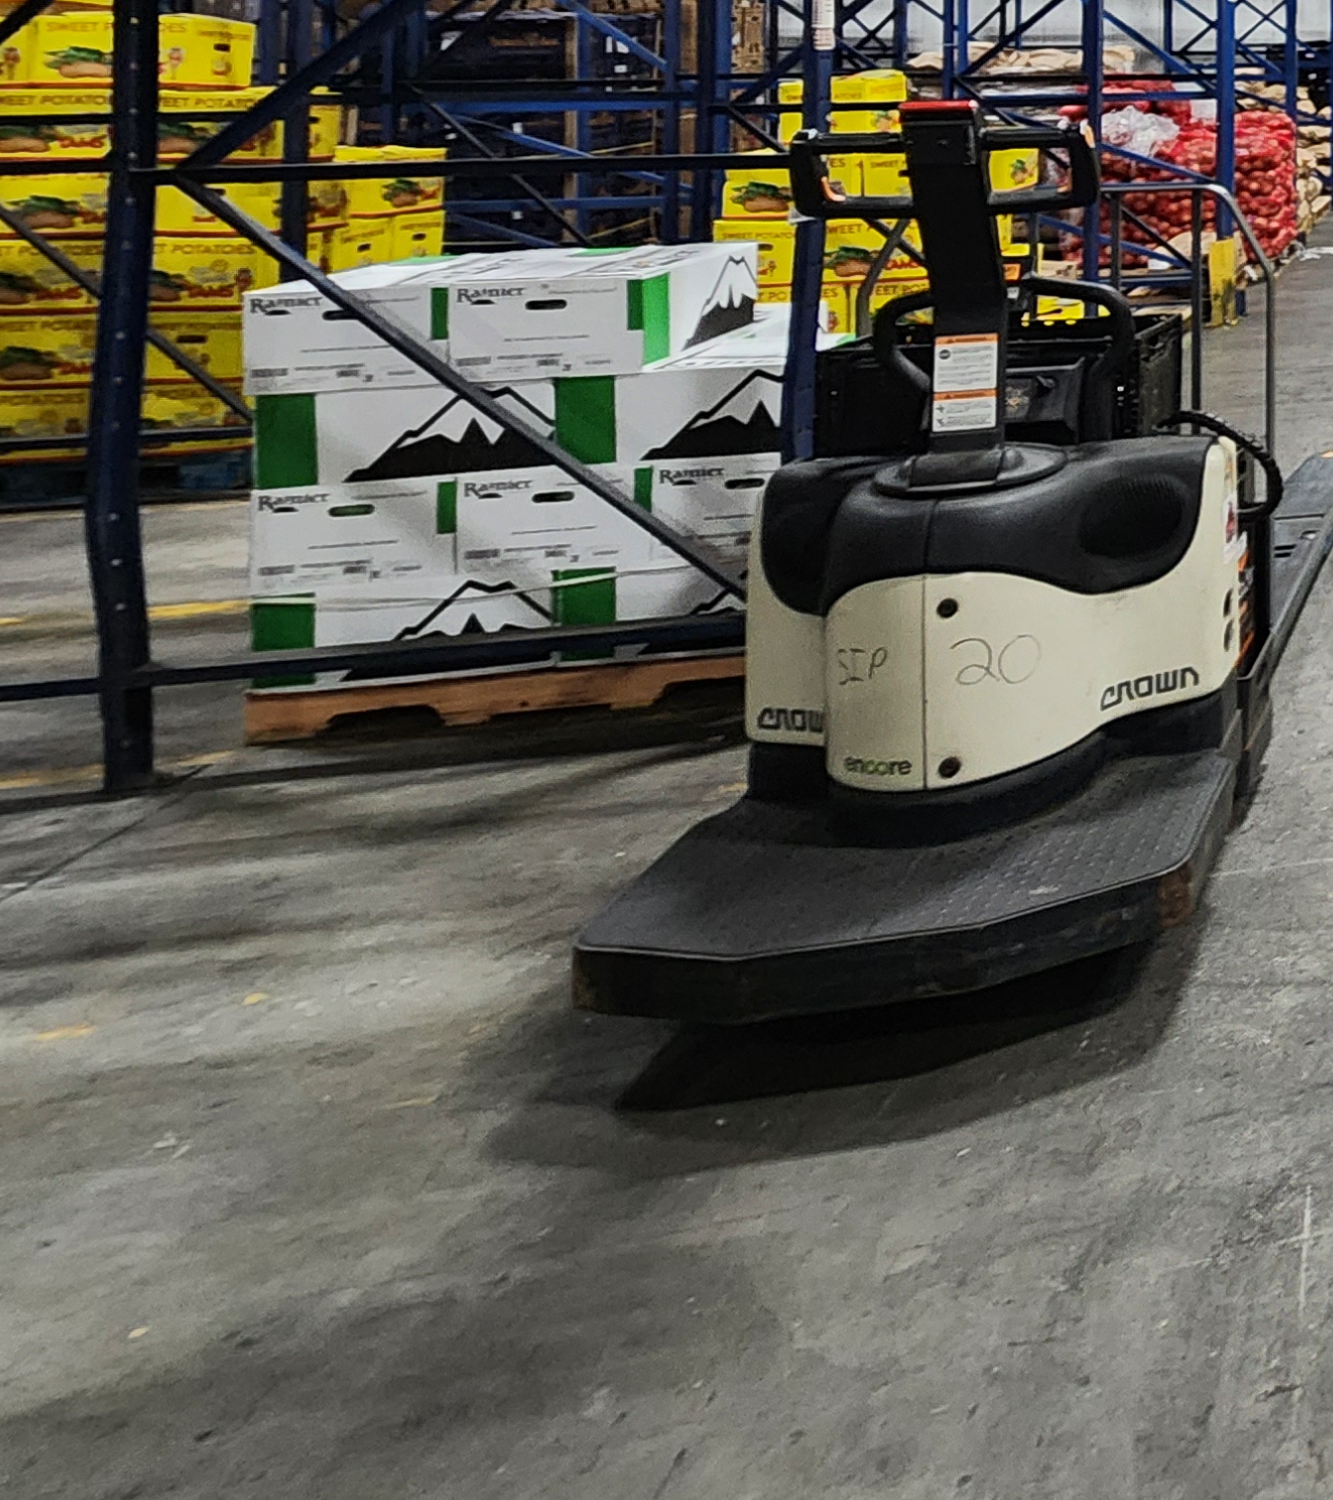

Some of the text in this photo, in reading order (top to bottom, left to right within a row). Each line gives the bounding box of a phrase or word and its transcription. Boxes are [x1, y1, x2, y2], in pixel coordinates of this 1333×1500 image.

[950, 634, 1042, 686] 20
[757, 707, 824, 733] CROW
[845, 756, 912, 776] encore
